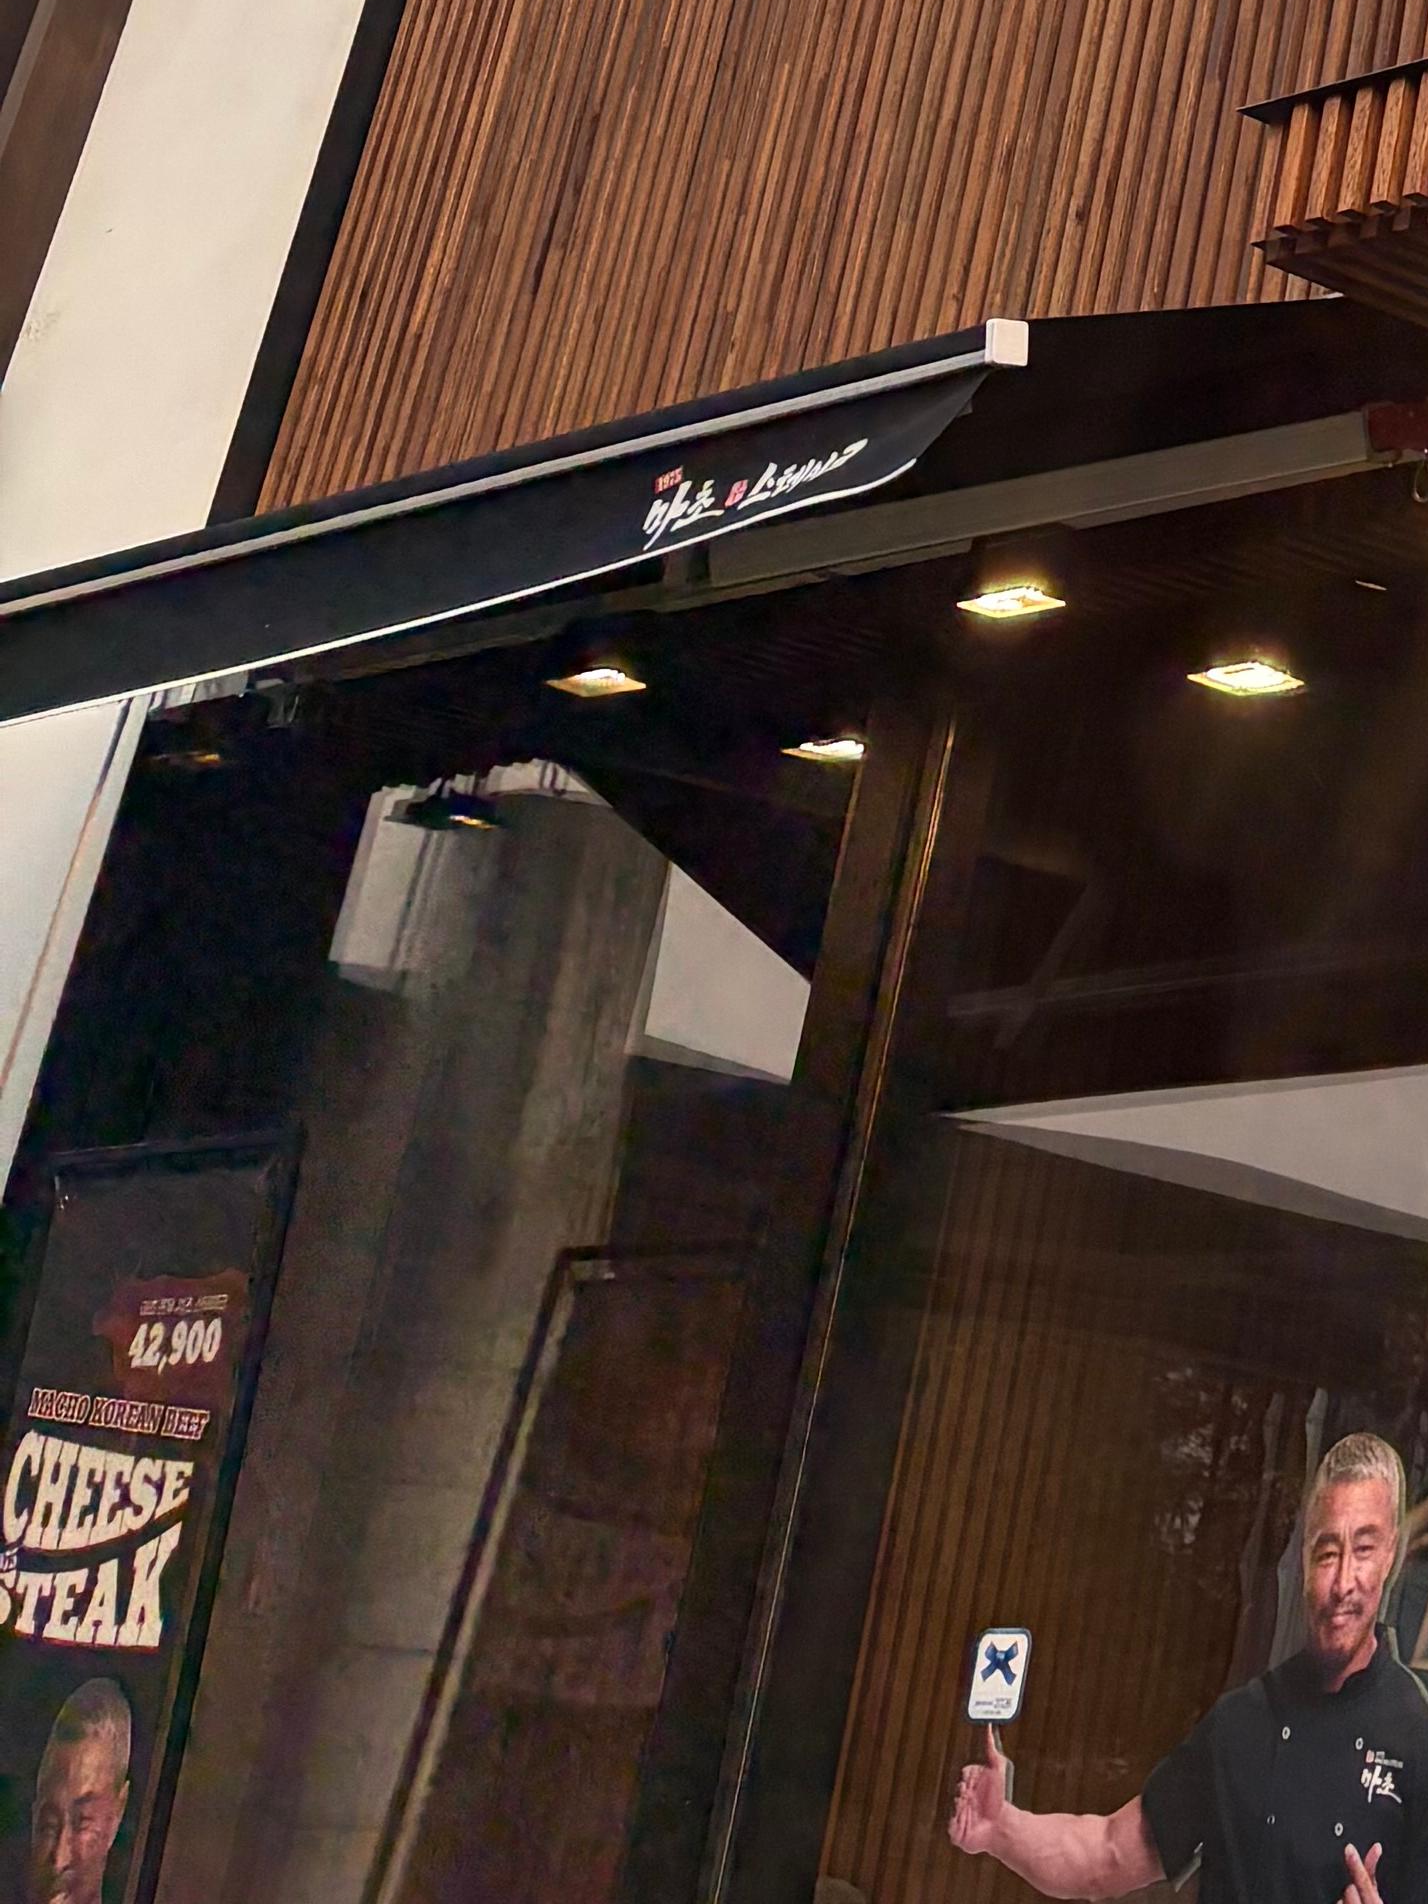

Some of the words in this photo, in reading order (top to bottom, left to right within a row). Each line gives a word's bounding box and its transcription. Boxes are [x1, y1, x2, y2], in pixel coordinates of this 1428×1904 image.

[642, 479, 726, 551] 마초
[737, 438, 869, 511] 스테이크
[128, 1317, 223, 1375] 42,900
[28, 1387, 92, 1425] MACHO
[89, 1396, 165, 1435] KOREAN
[161, 1406, 211, 1441] BEEF
[3, 1428, 195, 1551] CHEESE
